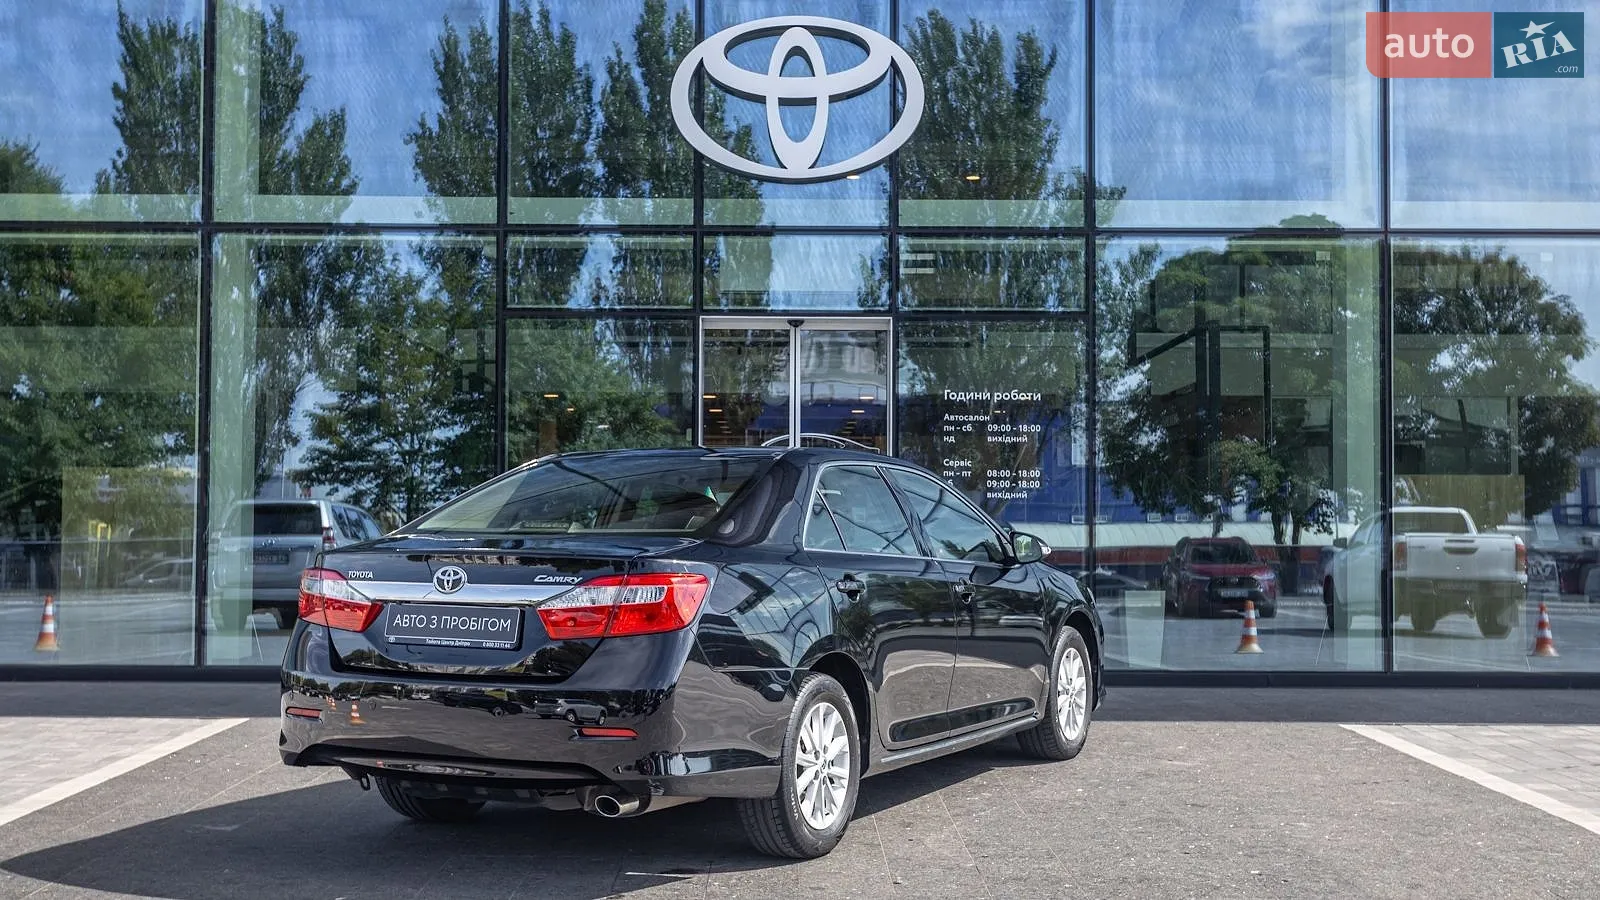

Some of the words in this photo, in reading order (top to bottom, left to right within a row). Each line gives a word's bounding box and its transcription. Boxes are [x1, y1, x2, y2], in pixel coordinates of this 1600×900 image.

[944, 389, 991, 402] Години
[994, 389, 1041, 402] роботи
[943, 413, 990, 421] Автосалон
[962, 423, 972, 432] сб
[987, 424, 1011, 432] 09:00
[1019, 424, 1041, 432] 18:00
[987, 435, 1028, 443] вихідний
[943, 459, 972, 468] Сервіс
[986, 480, 1010, 488] 09:00
[1018, 480, 1040, 488] 18:00
[986, 491, 1028, 499] вихідний
[348, 570, 374, 579] TOYOTA
[533, 574, 583, 585] CAMRY
[393, 613, 427, 628] АВТО
[441, 615, 512, 632] ПРОБІГОМ
